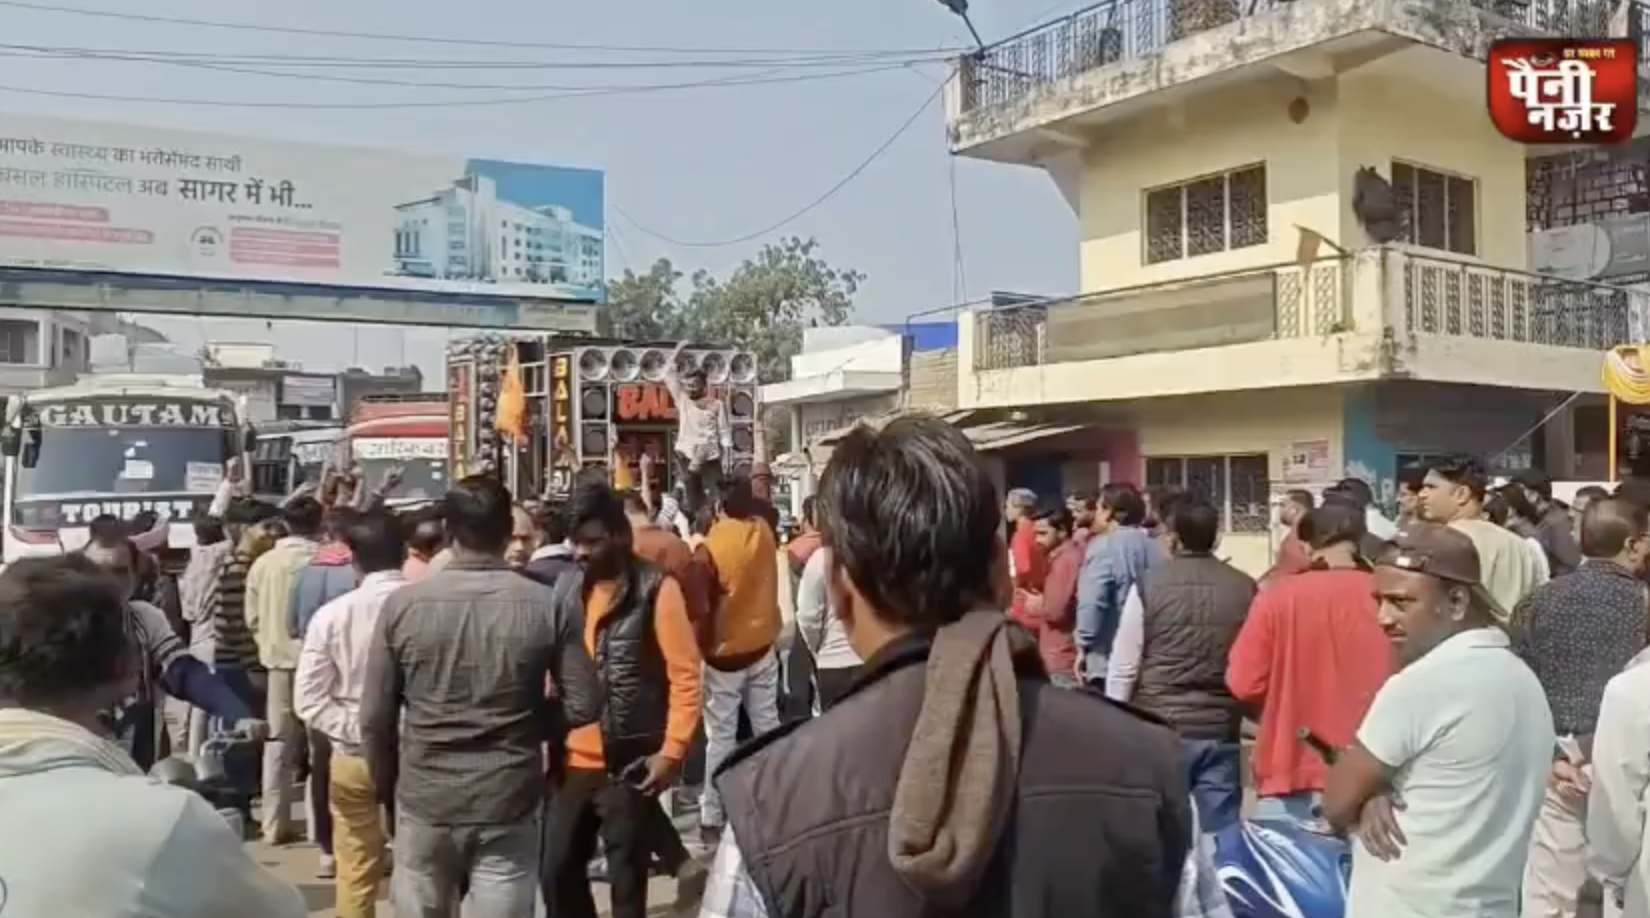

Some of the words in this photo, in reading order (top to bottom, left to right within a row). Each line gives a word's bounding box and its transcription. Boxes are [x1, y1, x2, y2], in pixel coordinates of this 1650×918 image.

[112, 147, 134, 163] का
[178, 178, 238, 204] सागर
[245, 177, 263, 205] में
[40, 405, 220, 427] GAUTAM
